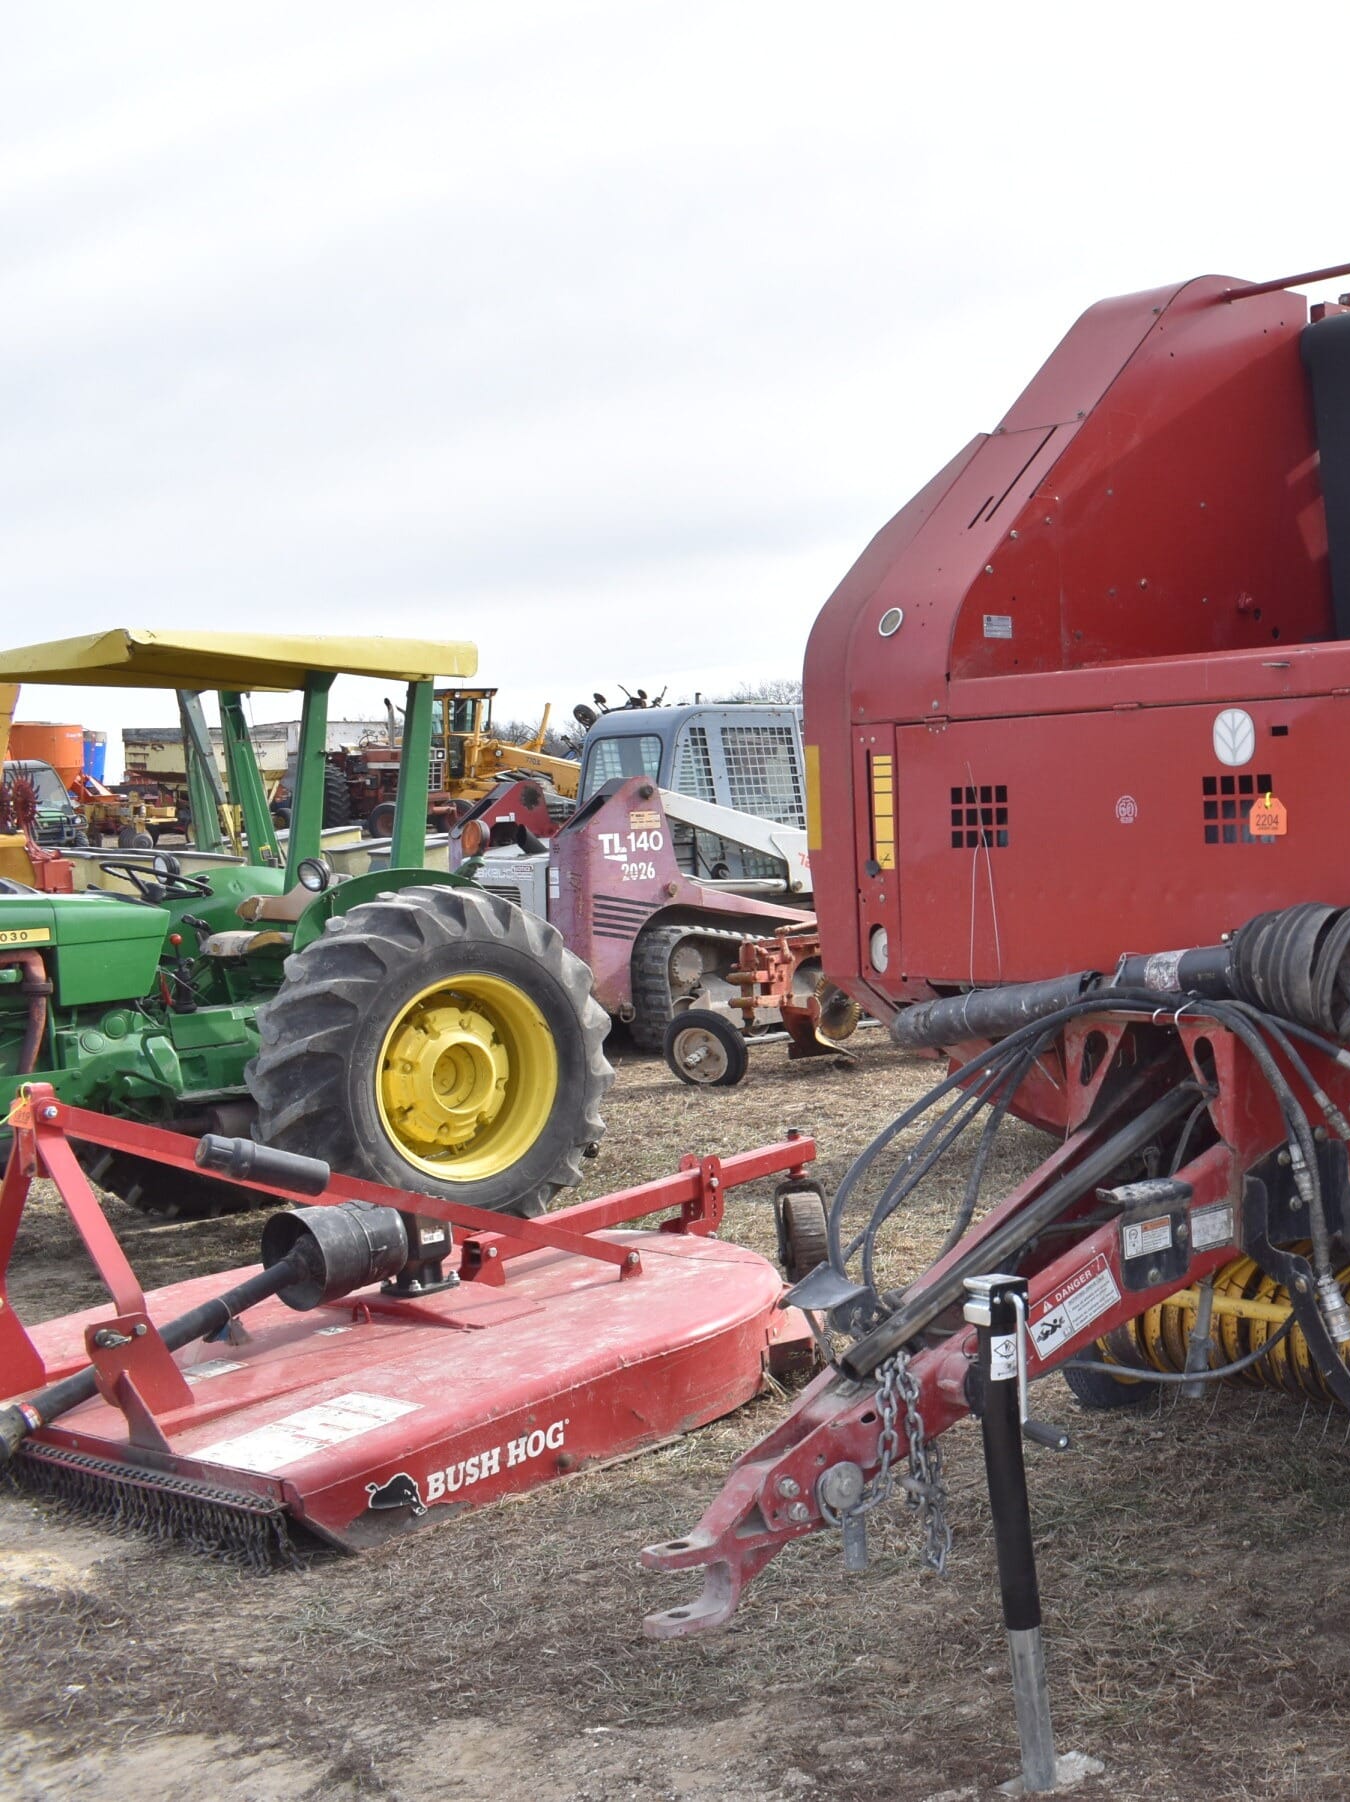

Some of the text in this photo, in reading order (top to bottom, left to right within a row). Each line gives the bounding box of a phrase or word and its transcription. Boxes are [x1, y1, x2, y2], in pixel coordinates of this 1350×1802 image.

[1256, 814, 1279, 826] 2204
[621, 862, 656, 881] 2026
[1055, 1270, 1092, 1302] DANGER
[426, 1420, 565, 1502] BUSH HOG
